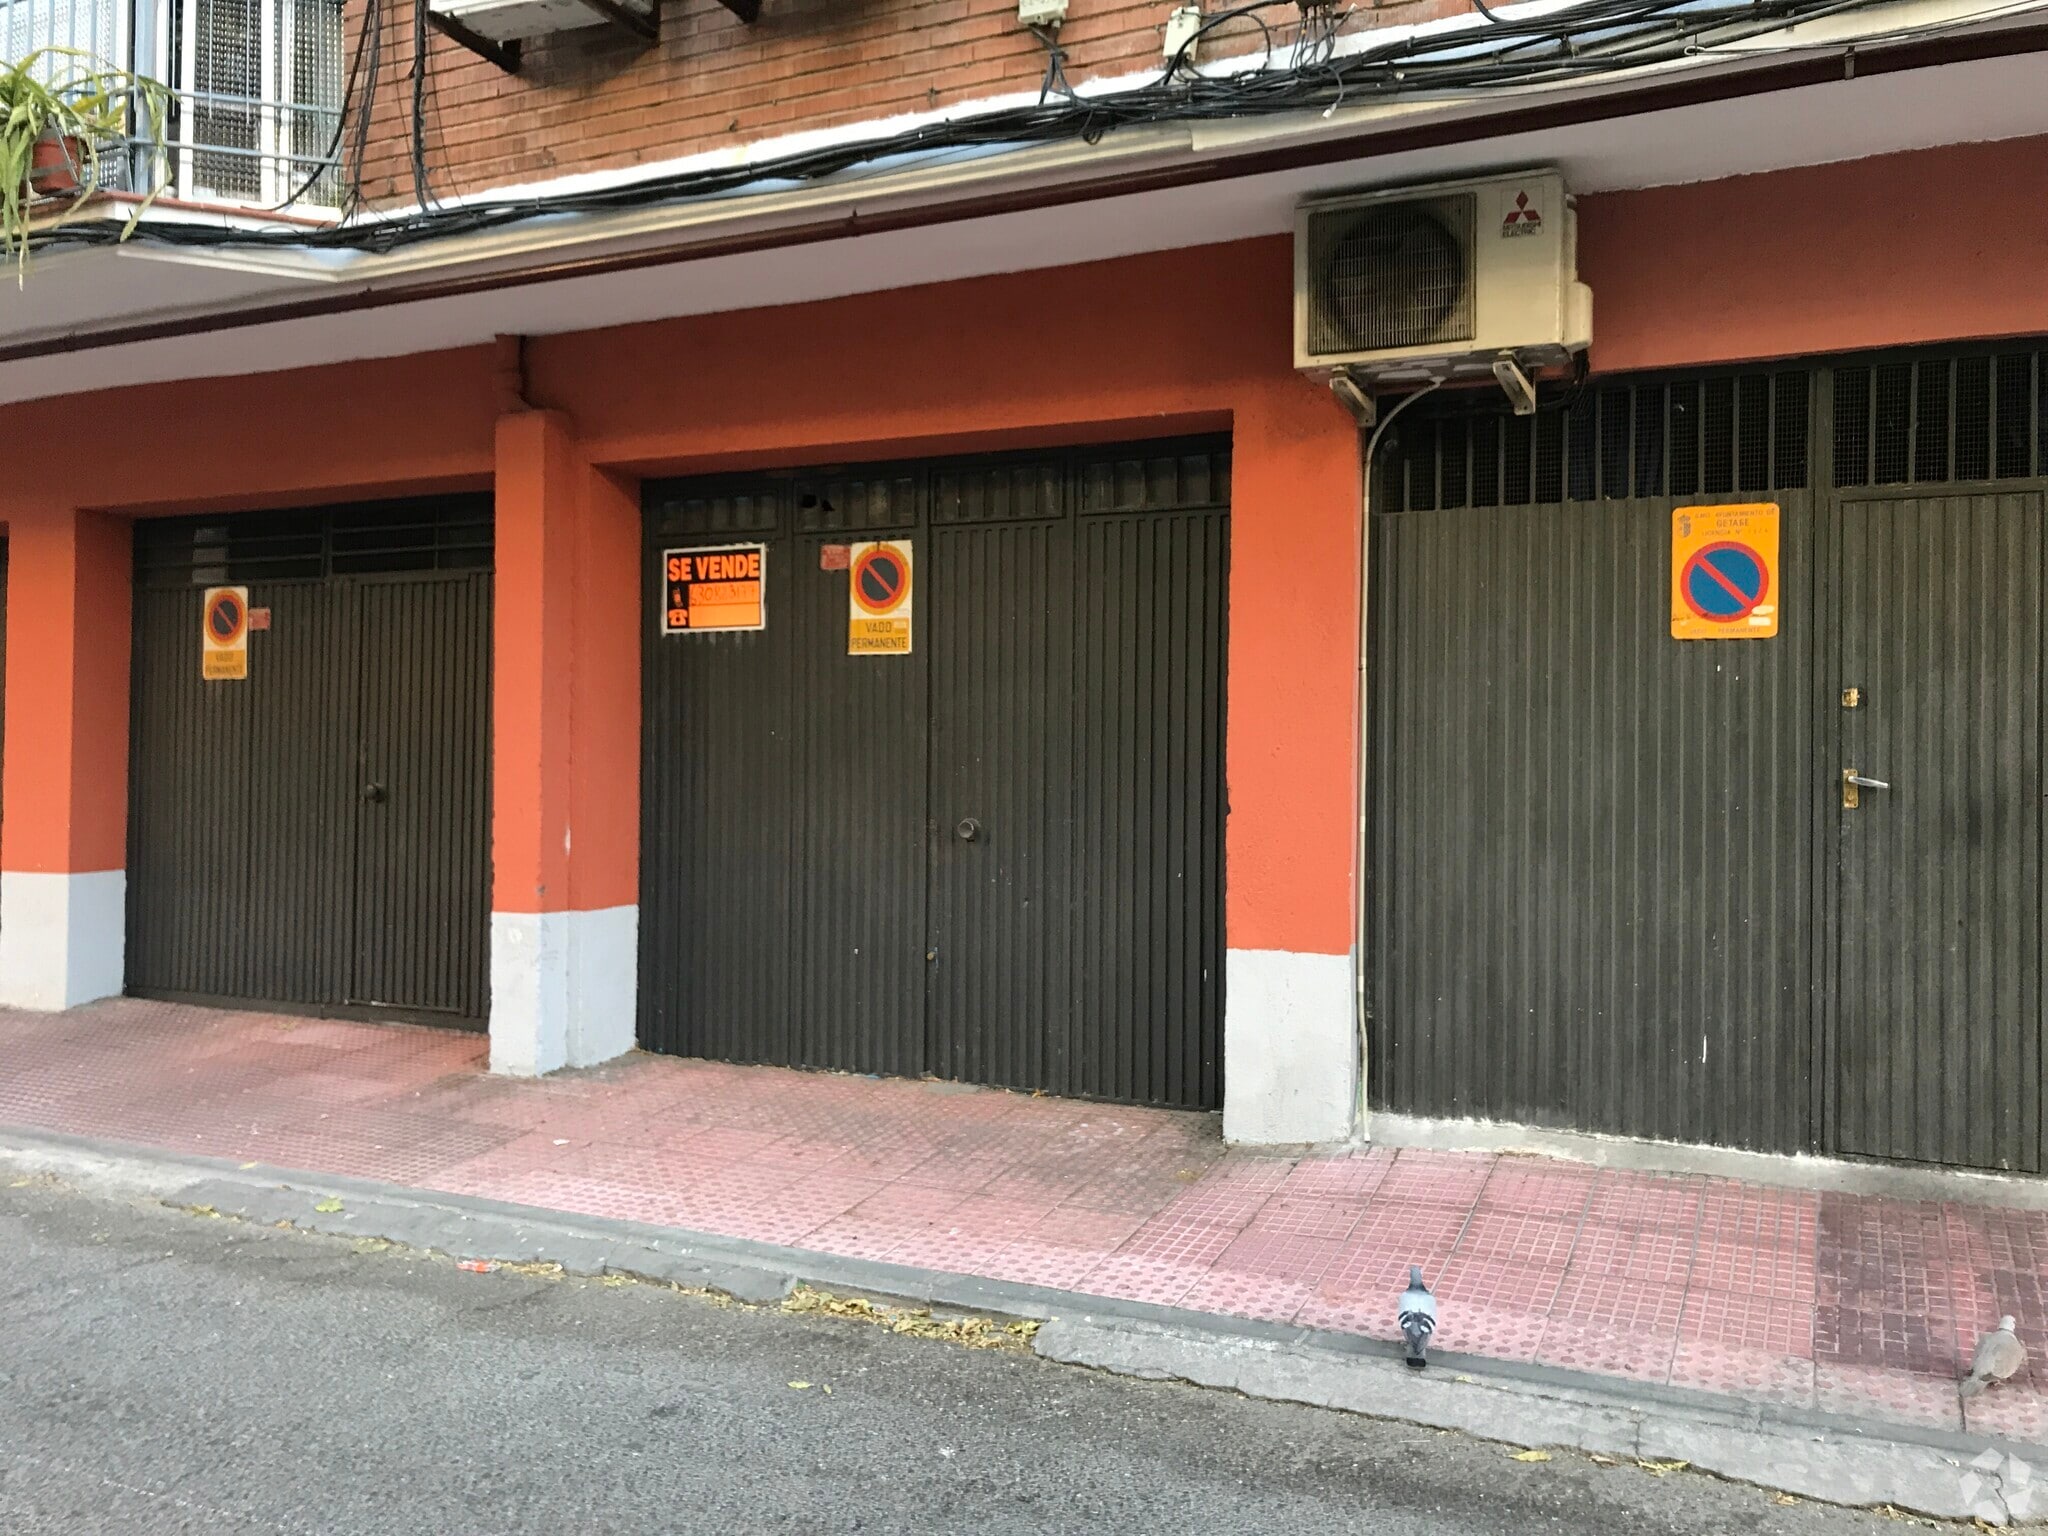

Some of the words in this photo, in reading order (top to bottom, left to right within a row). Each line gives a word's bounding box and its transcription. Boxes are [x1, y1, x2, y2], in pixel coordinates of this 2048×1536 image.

[668, 557, 692, 581] SE
[696, 553, 760, 580] VENDE
[865, 621, 893, 634] VADO
[851, 637, 907, 649] PERMANENTE
